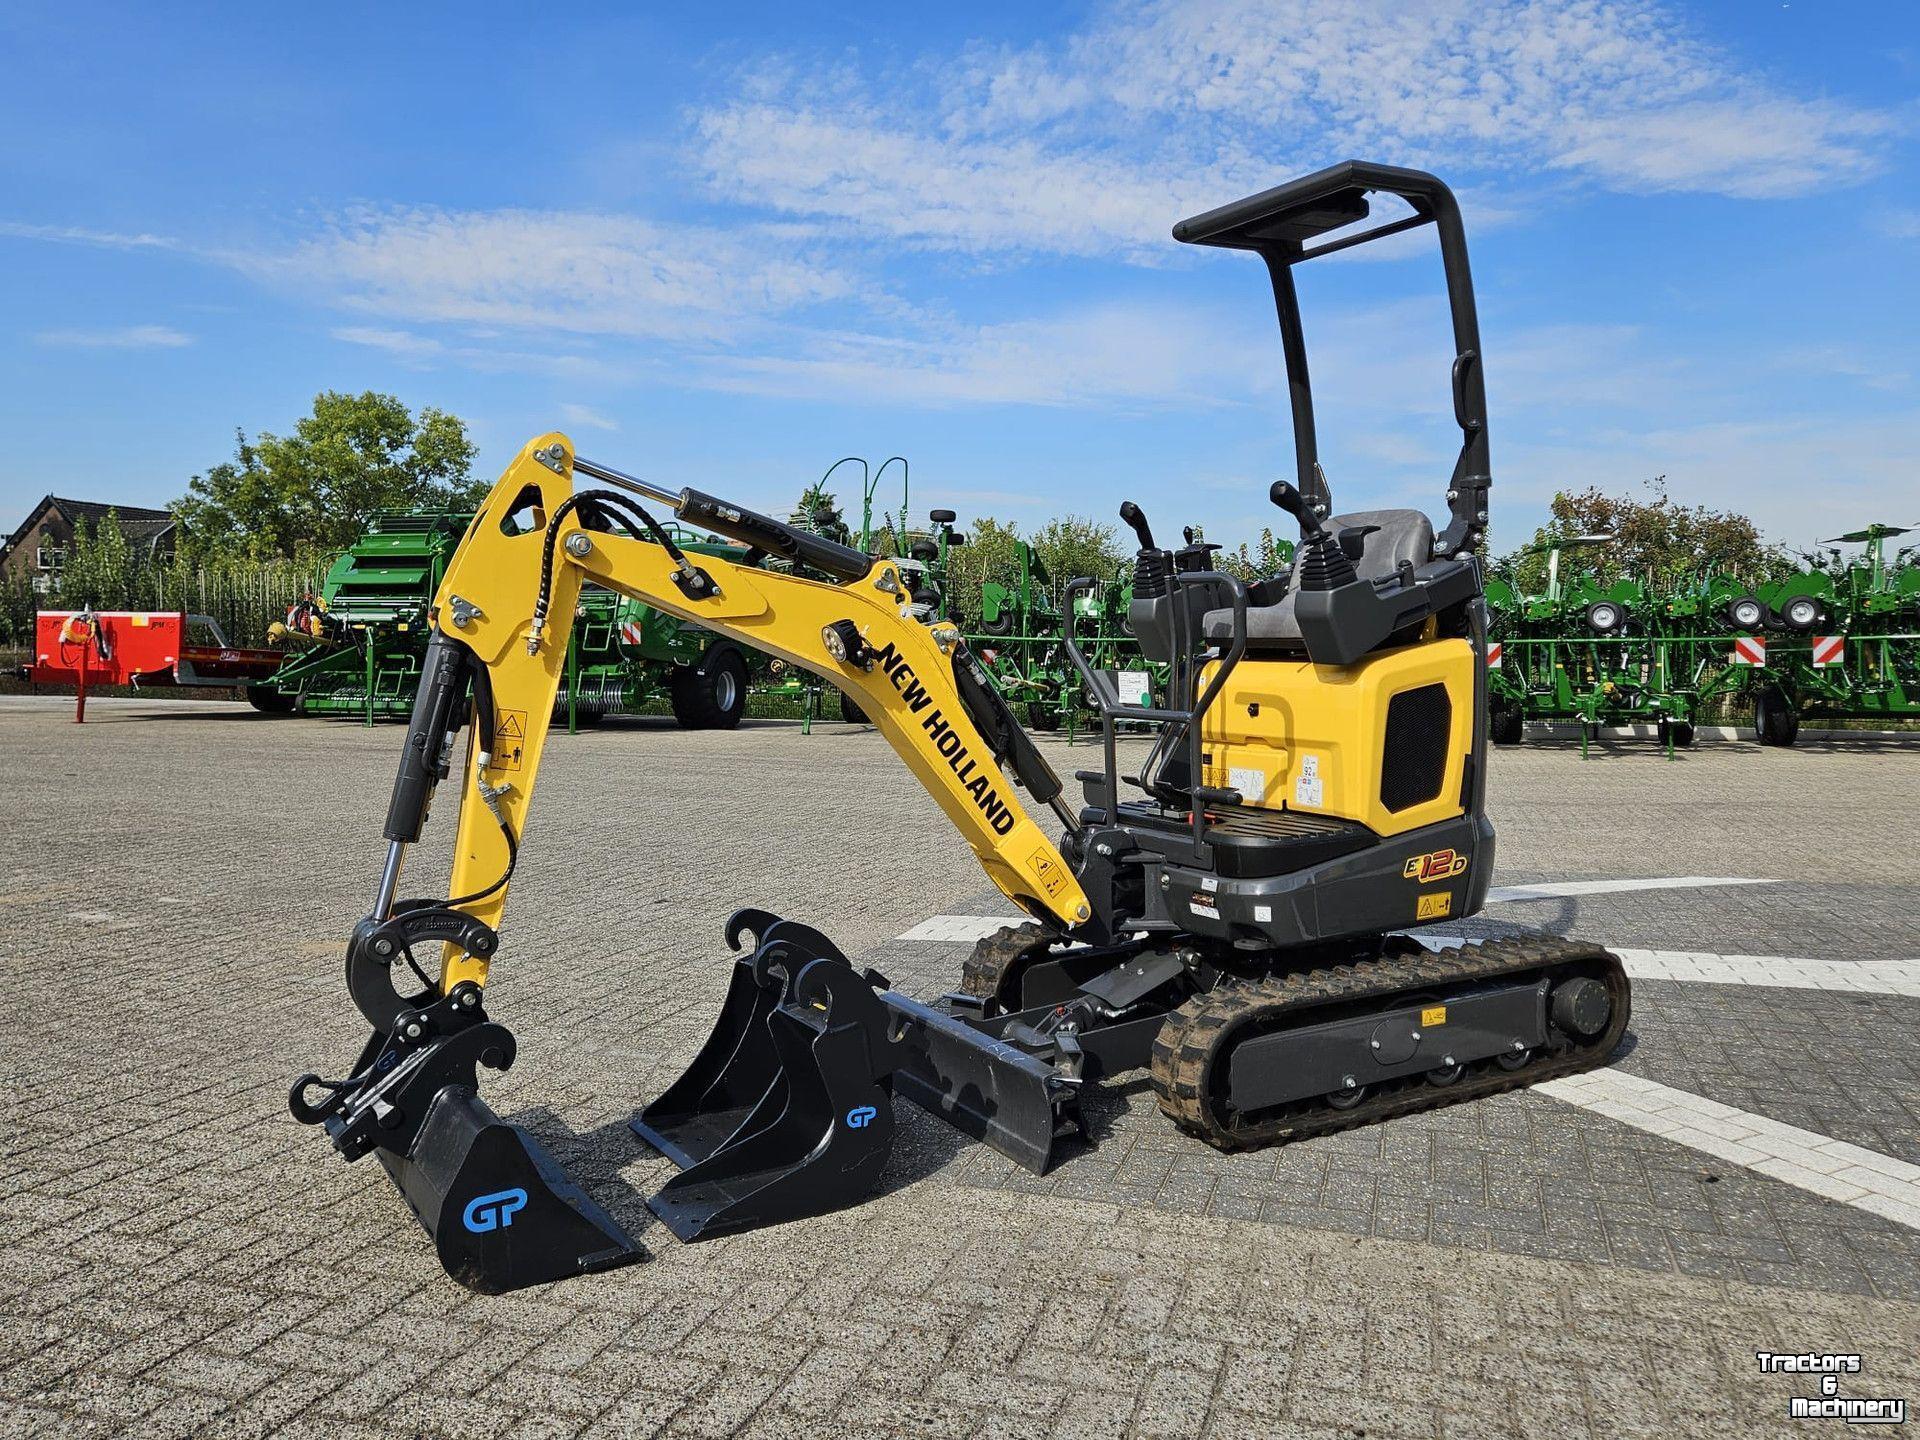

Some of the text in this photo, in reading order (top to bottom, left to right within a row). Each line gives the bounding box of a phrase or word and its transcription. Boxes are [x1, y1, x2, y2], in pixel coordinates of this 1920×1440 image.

[877, 642, 1015, 836] NEW HOLLAND
[847, 1107, 876, 1128] GP
[463, 1188, 528, 1233] GP
